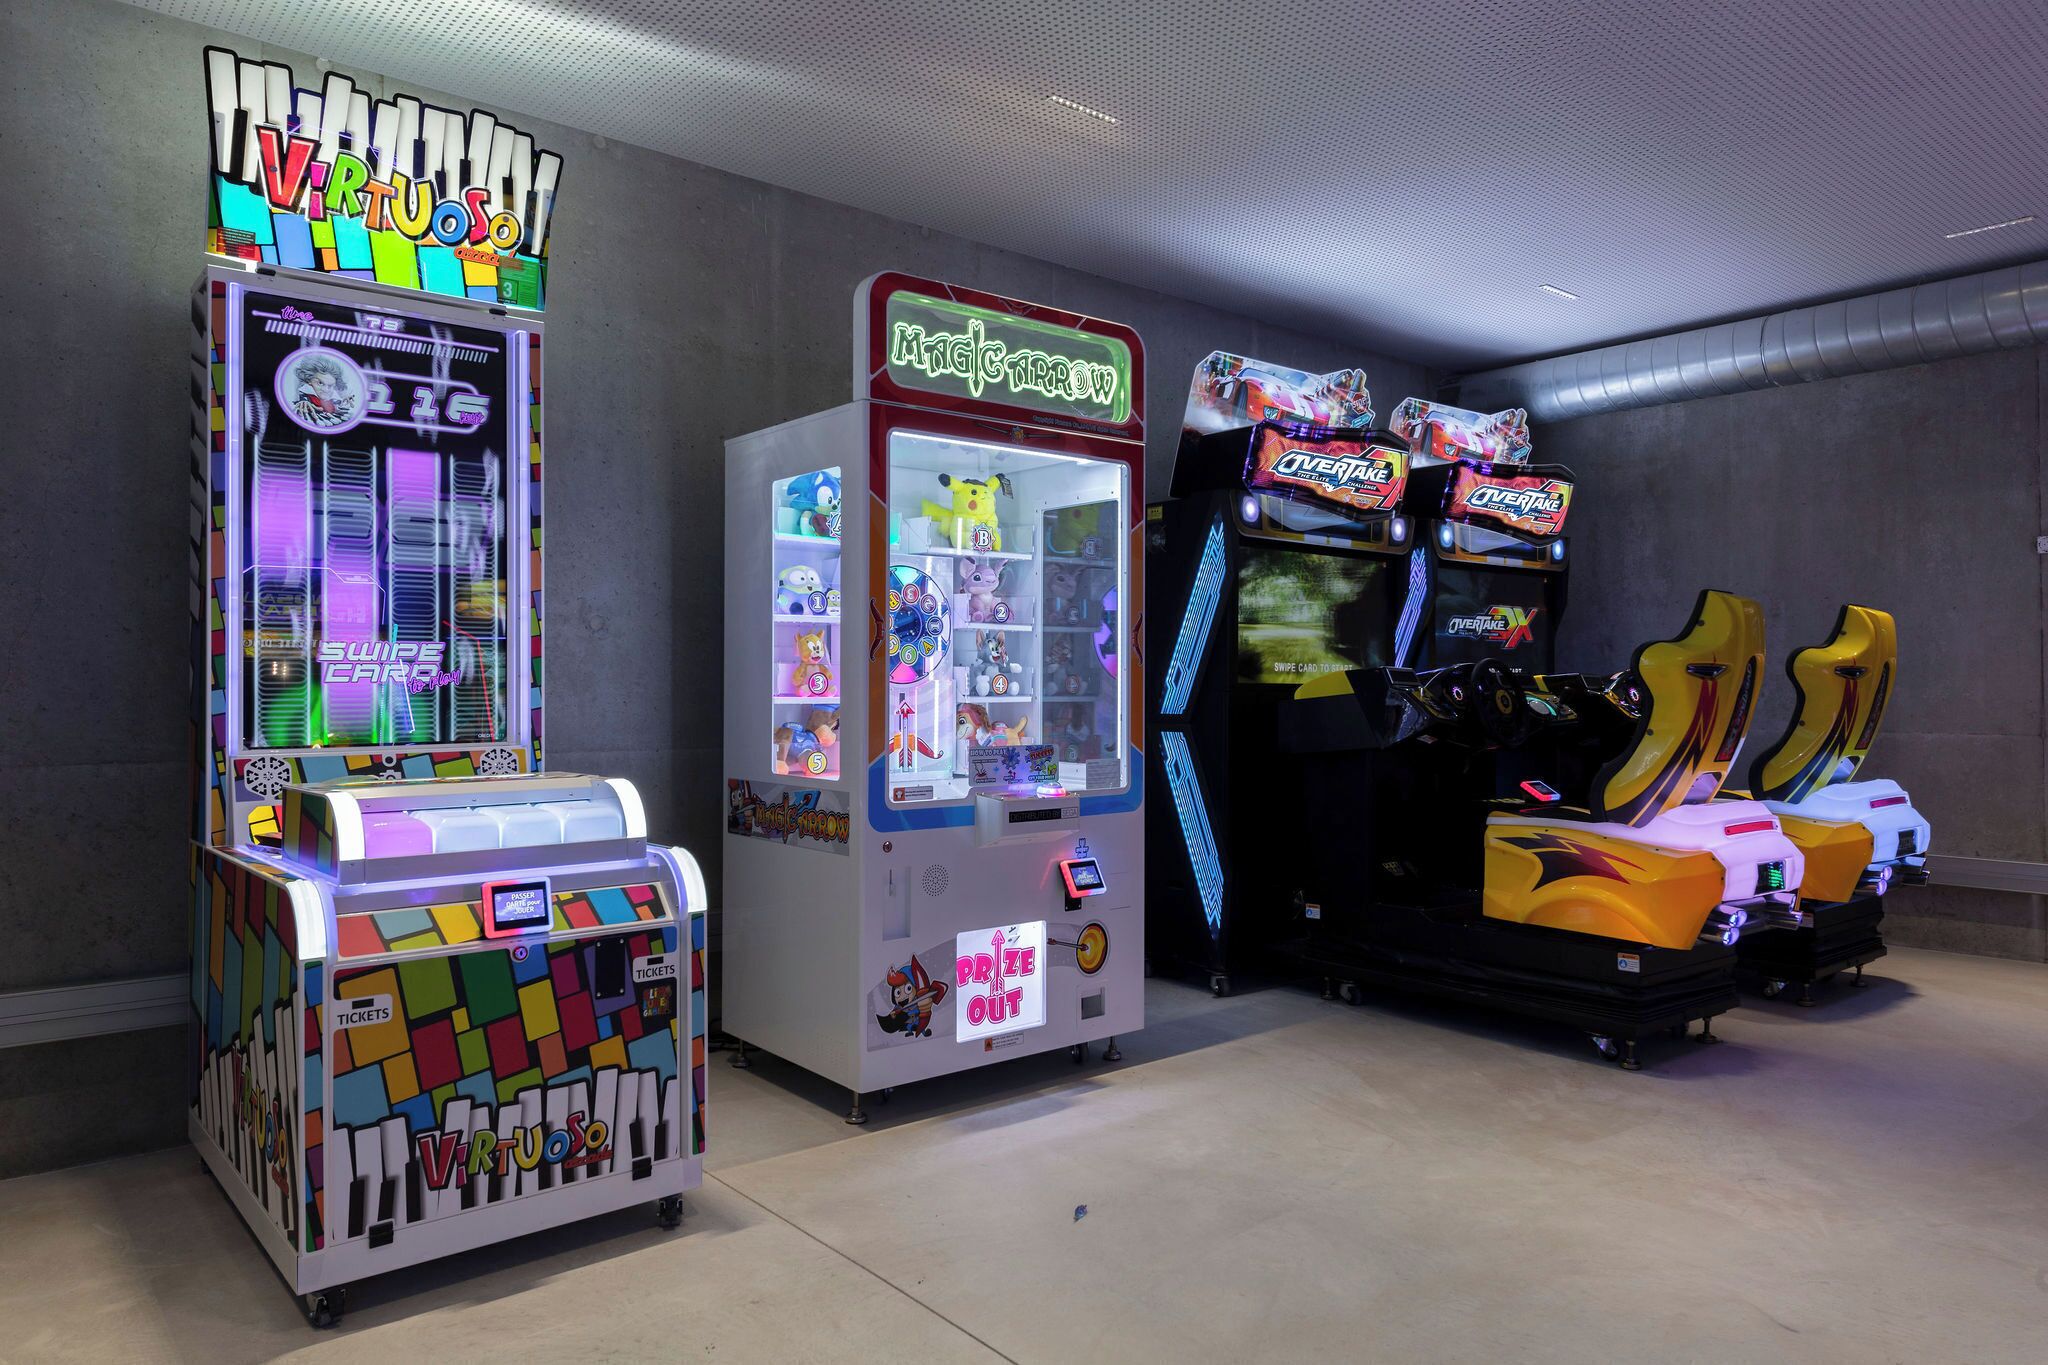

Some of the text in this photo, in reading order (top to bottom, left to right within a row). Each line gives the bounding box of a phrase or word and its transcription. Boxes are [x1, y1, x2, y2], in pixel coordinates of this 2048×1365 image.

[892, 319, 1117, 405] MAGIC ARROW
[1277, 453, 1388, 485] OVERTAKE
[1347, 481, 1377, 491] CHALLENGE
[1471, 488, 1559, 514] OVERTAKE
[978, 530, 990, 546] B
[813, 594, 822, 609] 1
[997, 607, 1006, 619] 2
[1448, 616, 1505, 635] OVERTAKE
[319, 641, 445, 661] SWIPE
[905, 648, 912, 661] 6
[325, 663, 439, 682] CARD
[1274, 662, 1296, 672] SWIPE
[1298, 663, 1317, 672] CARD
[1320, 664, 1329, 672] TO
[408, 669, 461, 694] to play
[813, 675, 823, 691] 3
[995, 677, 1005, 692] 4
[812, 755, 823, 771] 5
[798, 809, 849, 843] ARROW
[511, 892, 535, 900] PASSER
[956, 930, 1035, 994] PRIZE
[636, 964, 675, 979] TICKETS
[967, 987, 1023, 1026] OUT
[337, 1008, 389, 1025] TICKETS
